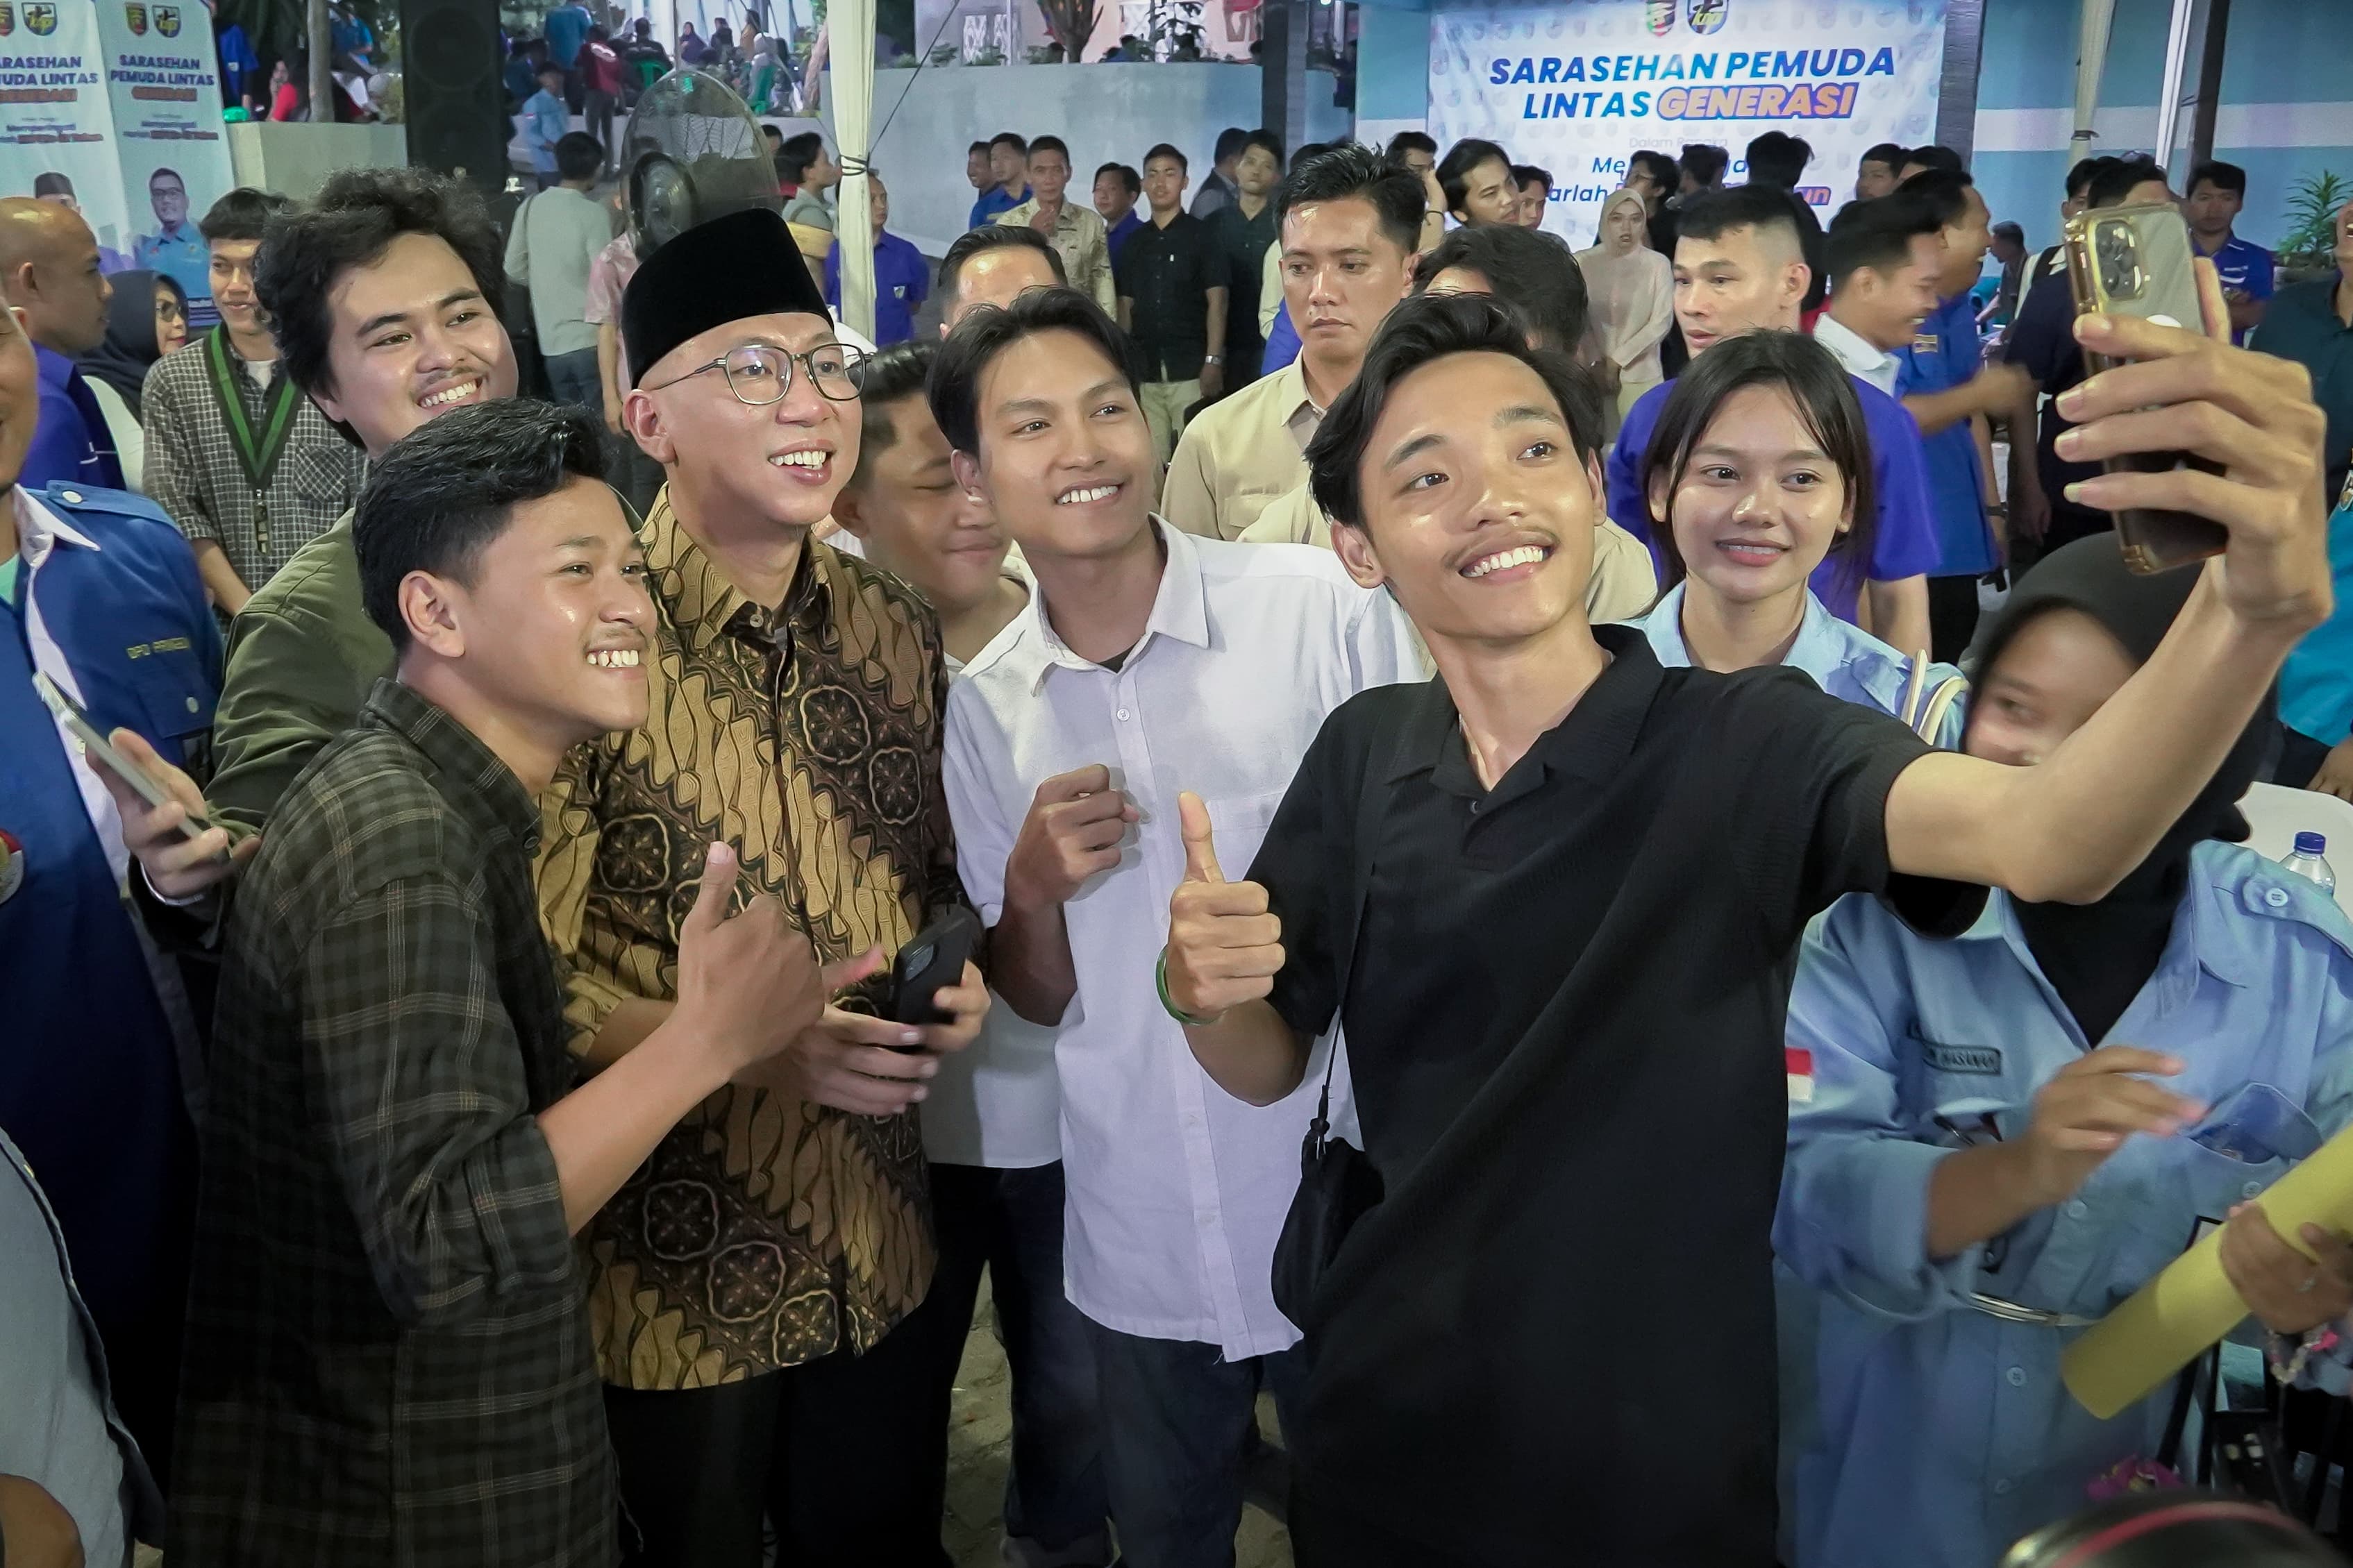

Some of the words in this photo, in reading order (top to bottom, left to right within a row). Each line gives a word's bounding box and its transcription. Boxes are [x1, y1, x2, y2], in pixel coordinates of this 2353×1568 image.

[0, 56, 82, 69] RASEHAN
[119, 54, 200, 69] SARASEHAN
[1490, 53, 1718, 84] SARASEHAN
[1725, 47, 1895, 78] PEMUDA
[41, 73, 98, 85] LINTAS
[110, 70, 166, 83] PEMUDA
[168, 72, 215, 85] LINTAS
[1523, 91, 1651, 119] LINTAS
[1657, 83, 1859, 120] GENERASI
[1629, 137, 1673, 148] Dalam
